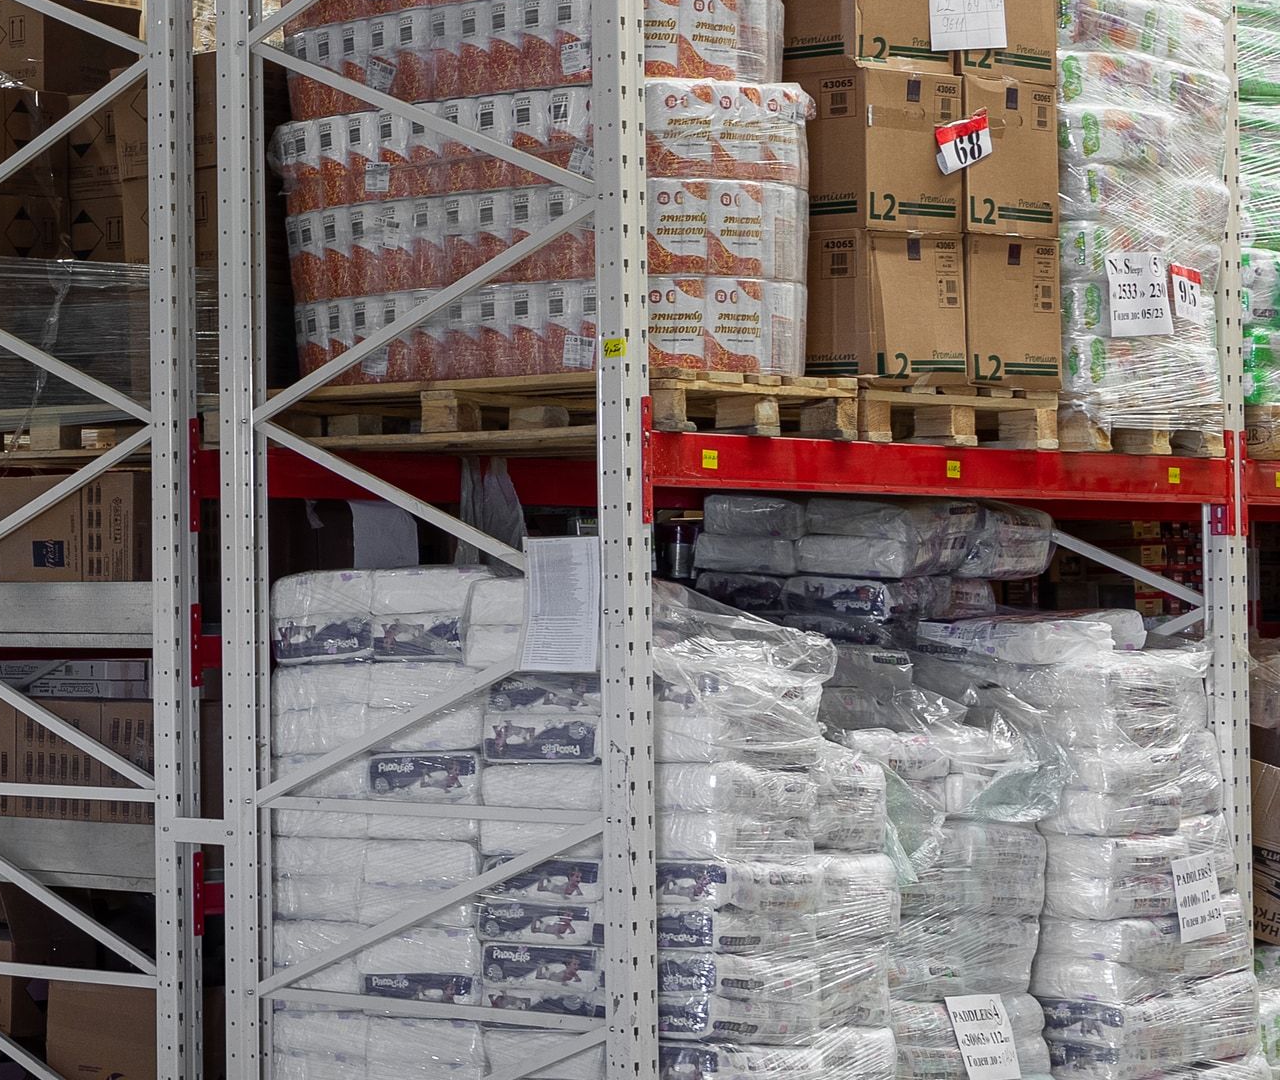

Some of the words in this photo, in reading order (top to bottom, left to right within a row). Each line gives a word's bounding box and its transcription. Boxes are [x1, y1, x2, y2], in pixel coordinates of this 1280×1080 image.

[790, 33, 844, 45] Premium
[858, 34, 889, 61] L2
[1016, 44, 1051, 56] Premium
[823, 78, 853, 89] 43065
[936, 85, 957, 95] 43065
[1033, 93, 1051, 103] 43065
[953, 132, 983, 164] 68
[920, 193, 957, 205] Premium
[1018, 199, 1053, 210] Premium
[870, 191, 896, 221] L2
[970, 195, 996, 225] L2
[823, 239, 854, 249] 43065
[936, 241, 956, 250] 43065
[1036, 247, 1055, 257] 43065
[1178, 280, 1197, 307] 95
[1141, 308, 1164, 319] 05/23
[931, 350, 965, 360] Premium
[1024, 353, 1058, 364] Premium
[877, 352, 910, 379] L2
[974, 354, 1002, 381] L2
[1176, 869, 1208, 887] PADDLERS
[953, 1009, 992, 1023] PADDLERS
